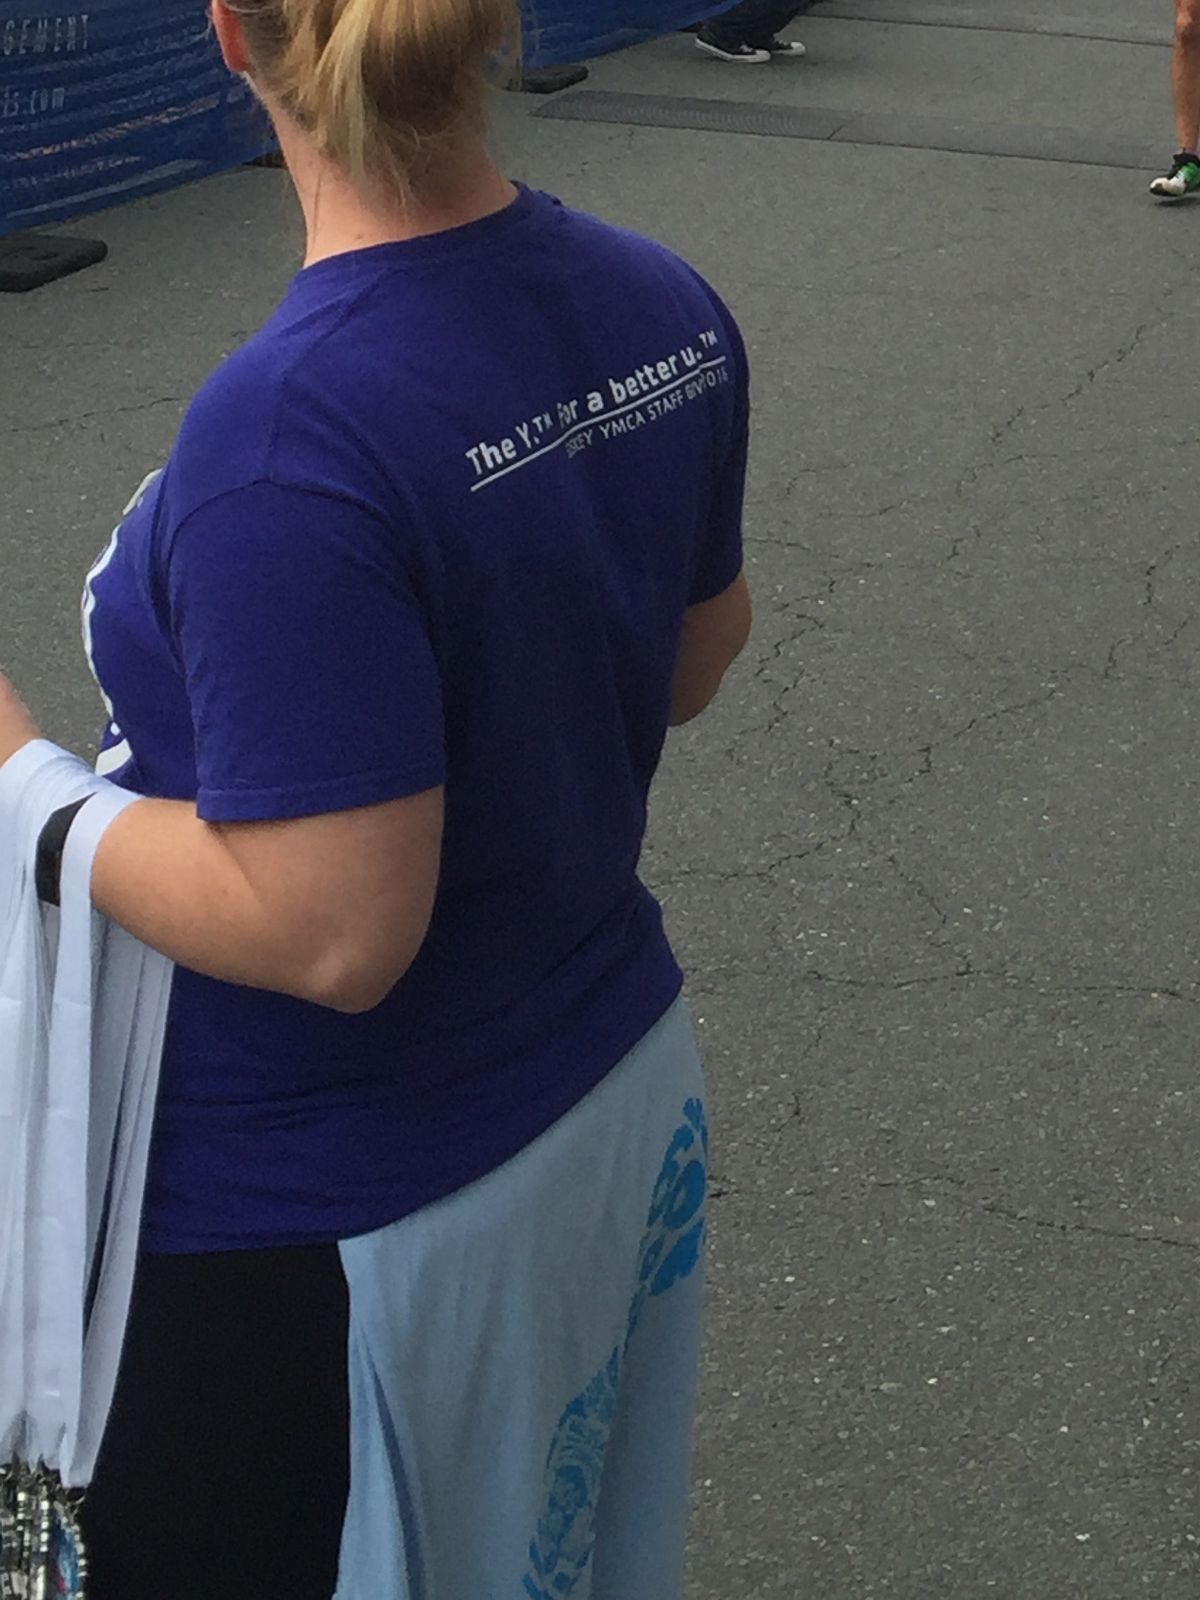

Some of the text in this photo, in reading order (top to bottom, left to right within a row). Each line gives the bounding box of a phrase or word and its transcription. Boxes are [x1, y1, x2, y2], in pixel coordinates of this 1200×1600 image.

[465, 435, 517, 476] The
[586, 390, 605, 414] a
[608, 354, 679, 404] better
[599, 411, 647, 440] YMCA
[647, 388, 685, 421] STAFF
